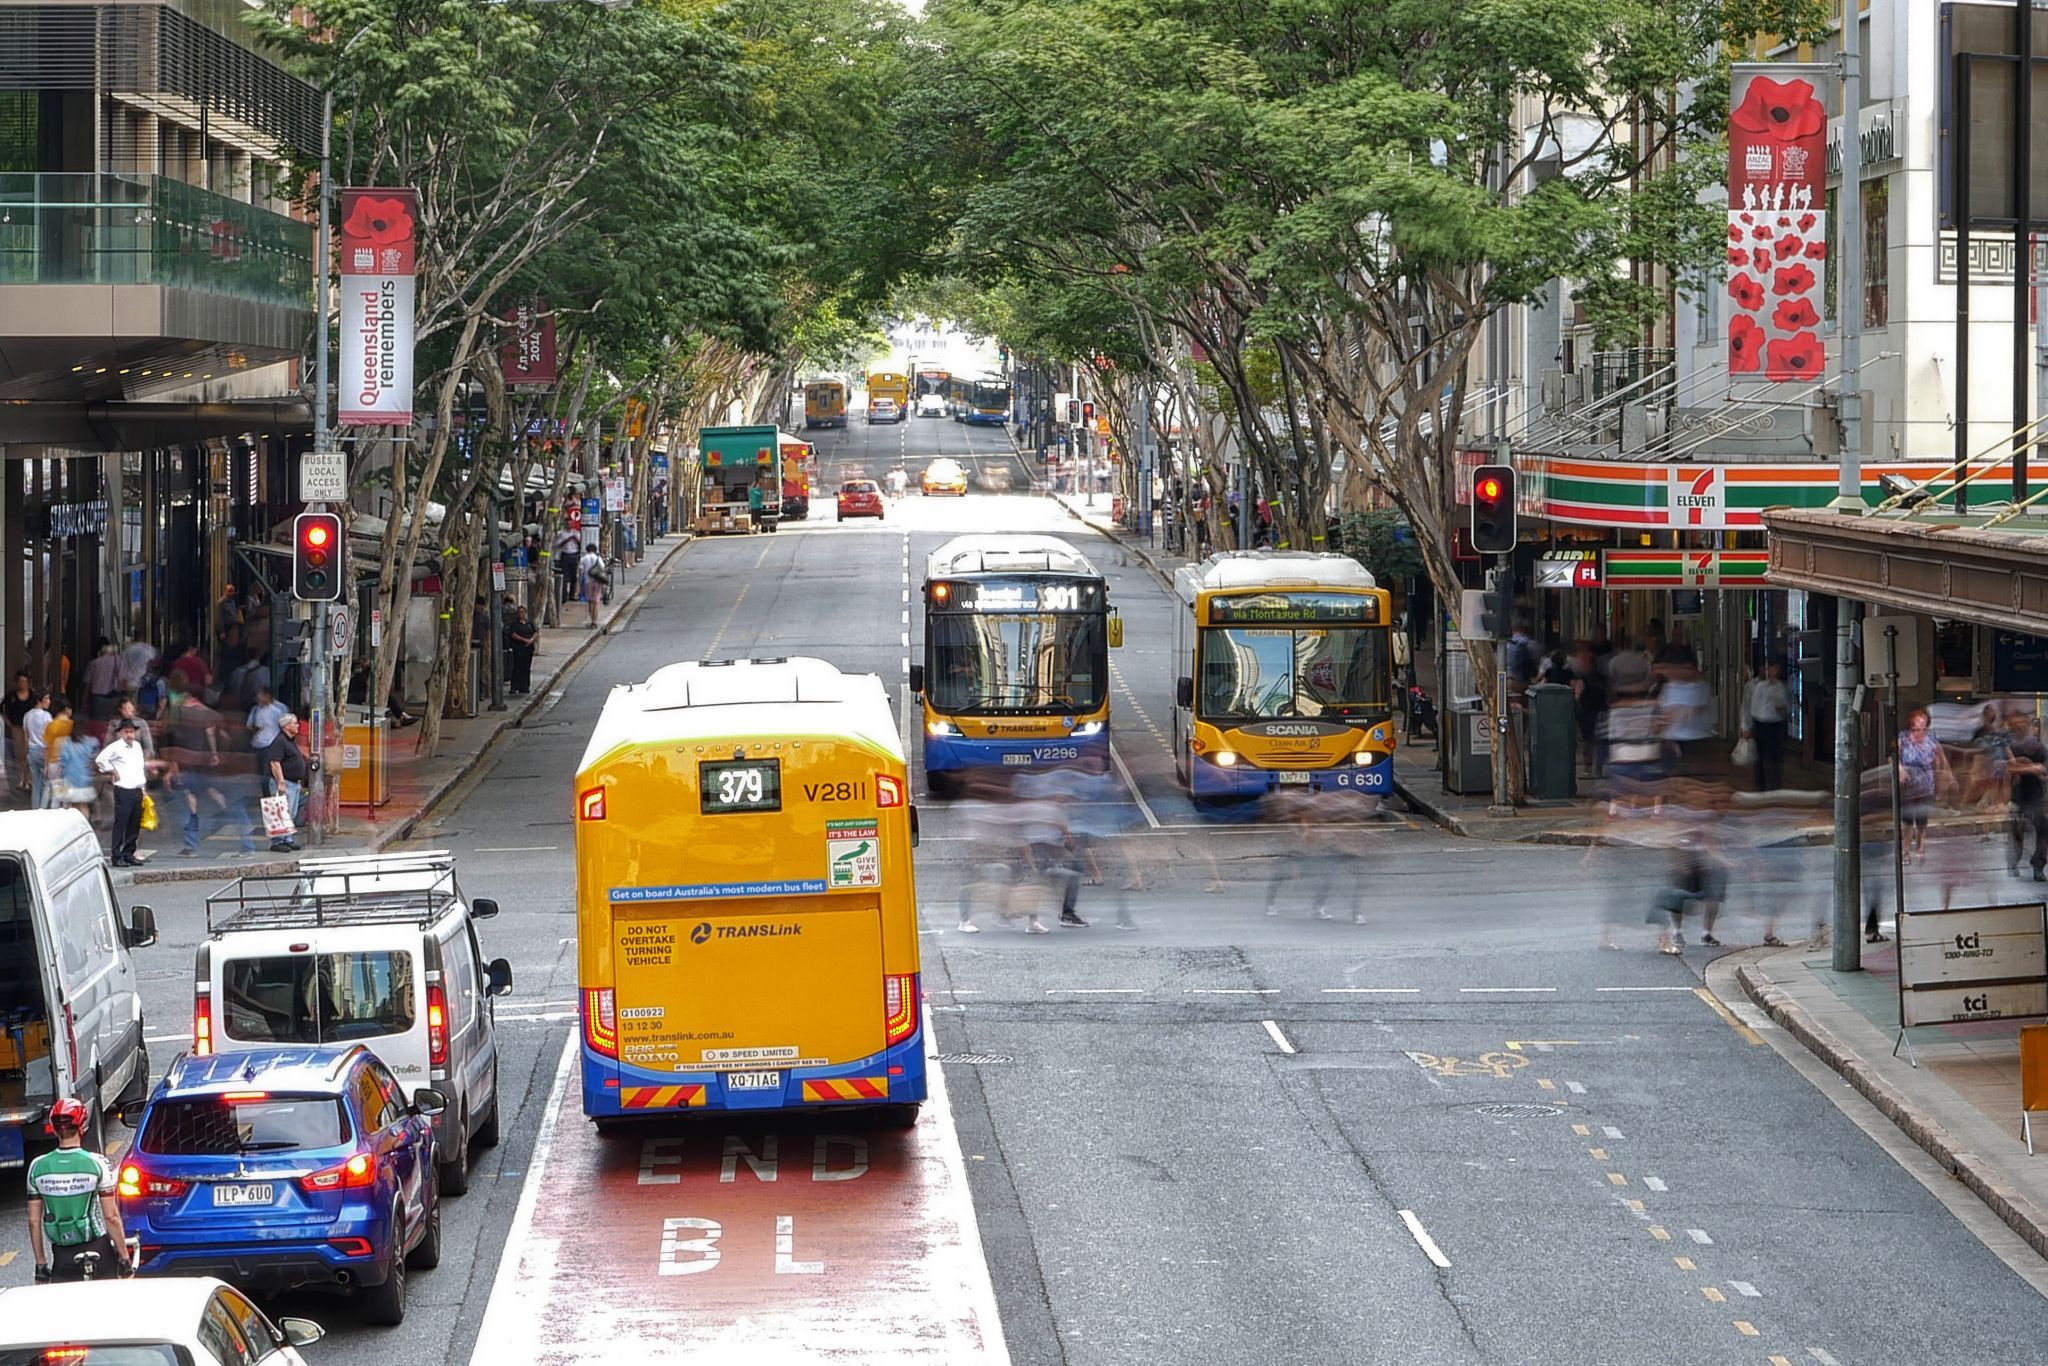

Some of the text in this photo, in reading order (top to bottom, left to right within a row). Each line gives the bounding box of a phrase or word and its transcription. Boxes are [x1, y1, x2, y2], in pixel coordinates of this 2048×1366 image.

[381, 280, 395, 388] remembers
[360, 292, 379, 407] Queensland
[304, 457, 342, 465] BUSES &
[309, 467, 337, 476] LOCAL
[306, 478, 340, 487] ACCESS
[314, 489, 332, 497] ONLY
[1233, 609, 1247, 619] via
[1303, 608, 1317, 619] Rd
[335, 623, 346, 640] 40
[1266, 725, 1318, 735] SCANIA
[1033, 747, 1078, 760] V2296
[1338, 774, 1383, 786] G 630
[719, 769, 762, 803] 379
[803, 782, 866, 802] V2811
[856, 856, 876, 864] GIVE
[612, 890, 630, 899] Get
[646, 888, 672, 898] board
[674, 886, 720, 896] Australia's
[722, 886, 744, 894] most
[746, 884, 782, 893] modern
[784, 883, 800, 892] bus
[802, 882, 823, 890] fleet
[628, 926, 668, 935] DO NOT
[717, 924, 802, 938] TRANSLink
[620, 935, 676, 946] OVERTAKE
[1955, 932, 1980, 950] tci
[625, 946, 672, 956] TURNING
[627, 956, 671, 966] VEHICLE
[1963, 993, 1988, 1012] tci
[621, 1008, 663, 1018] Q100922
[622, 1021, 662, 1031] 13 12 30
[623, 1031, 734, 1043] www.translink.com.au
[624, 1053, 679, 1063] VOLVO
[732, 1050, 759, 1058] SPEED
[762, 1049, 794, 1057] LIMITED
